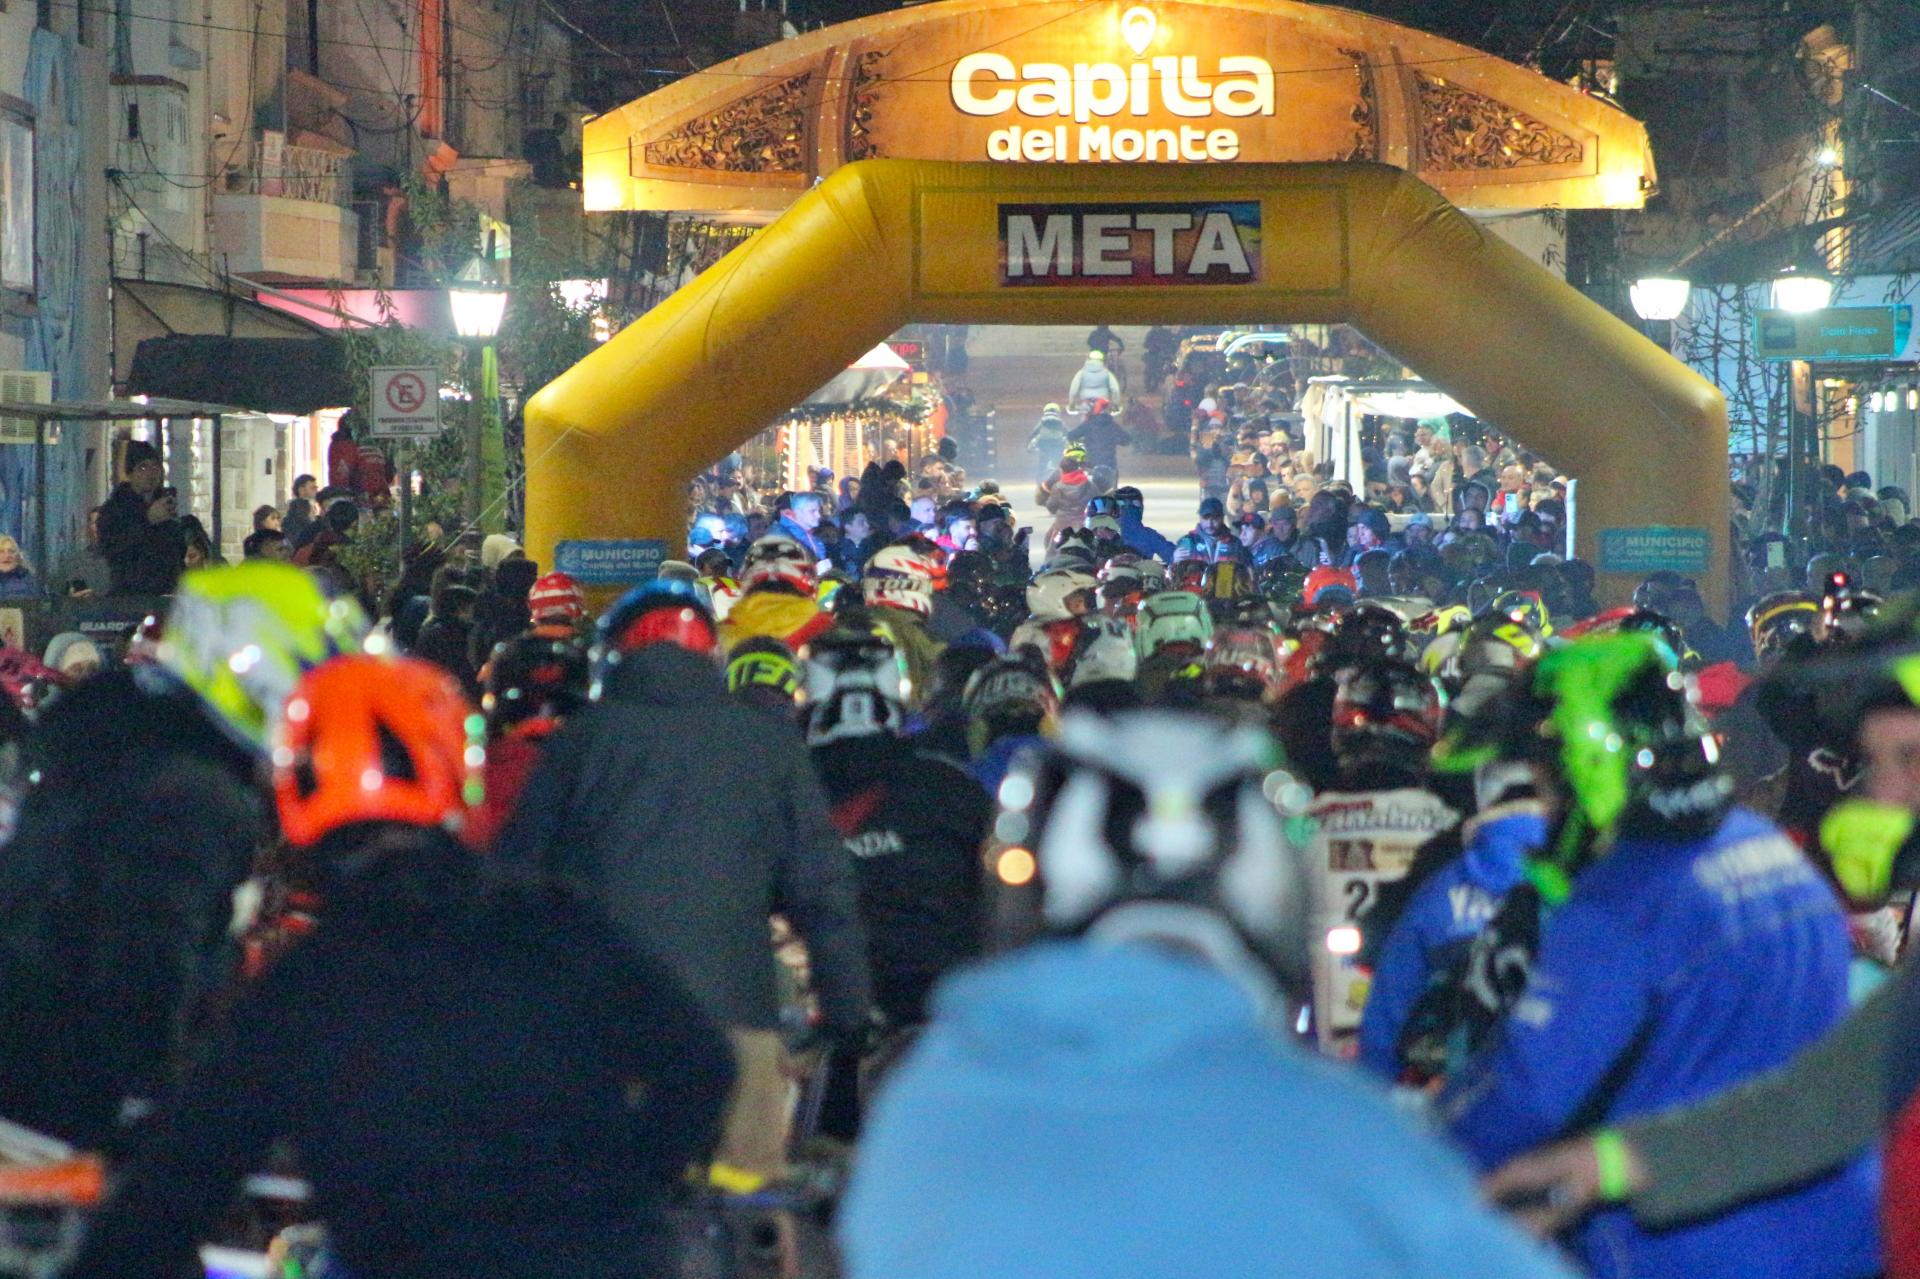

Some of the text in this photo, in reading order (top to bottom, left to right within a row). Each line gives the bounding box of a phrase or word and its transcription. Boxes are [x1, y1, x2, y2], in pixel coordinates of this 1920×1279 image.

[951, 53, 1275, 122] Capilla
[986, 125, 1240, 161] del Monte
[1006, 212, 1251, 277] META
[581, 548, 660, 560] MUNICIPIO
[1625, 536, 1704, 548] MUNICIPIO
